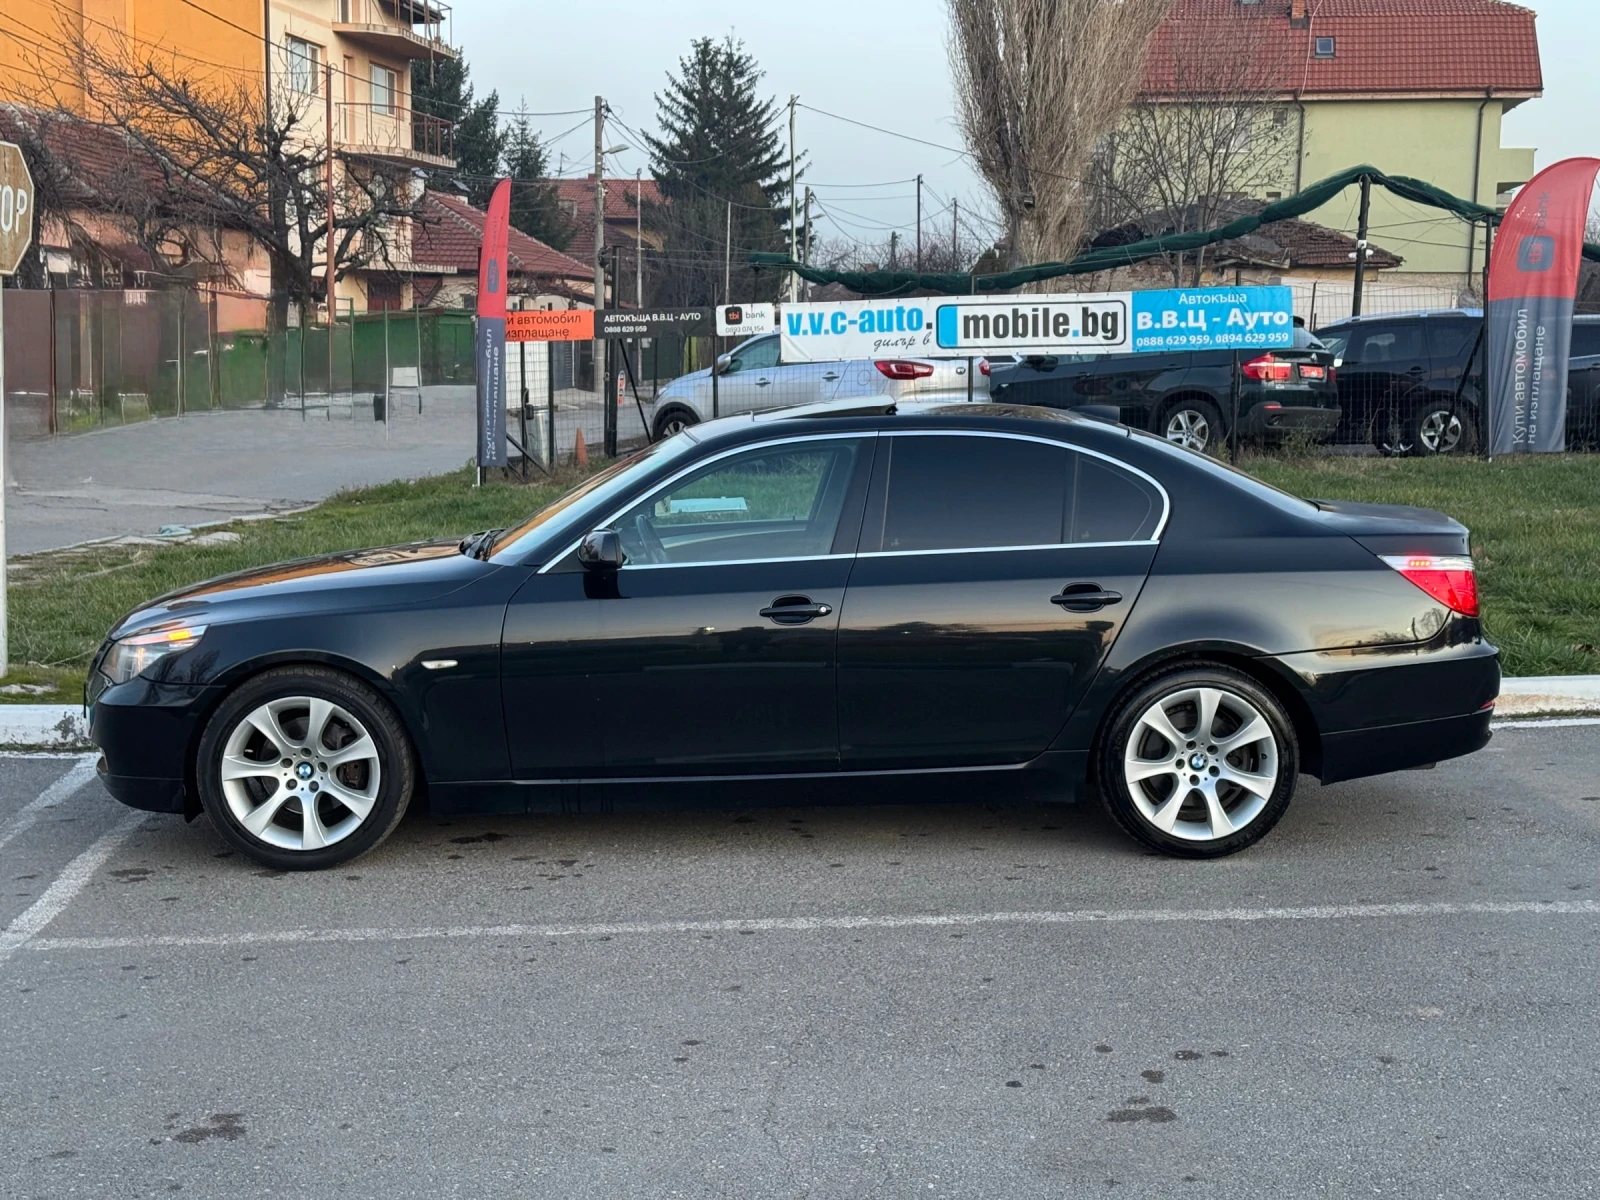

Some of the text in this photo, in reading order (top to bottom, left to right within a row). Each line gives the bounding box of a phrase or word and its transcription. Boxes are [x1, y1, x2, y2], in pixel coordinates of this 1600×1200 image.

[0, 184, 27, 233] OP
[1178, 292, 1247, 305] Автокъща
[517, 314, 581, 324] автомобил
[604, 315, 651, 323] АВТОКЪЩА
[652, 313, 674, 322] В.В.Ц
[680, 313, 701, 321] АУТО
[728, 311, 766, 320] tbi bank
[1136, 309, 1207, 331] В.В.Ц
[1226, 307, 1289, 330] Ауто
[963, 307, 1118, 341] mobile.bg
[506, 329, 570, 338] изплащане
[1136, 332, 1289, 347] 0888 629 959, 0894 629 959
[1512, 309, 1529, 445] Купи автомобил
[1527, 325, 1546, 444] на изплащане
